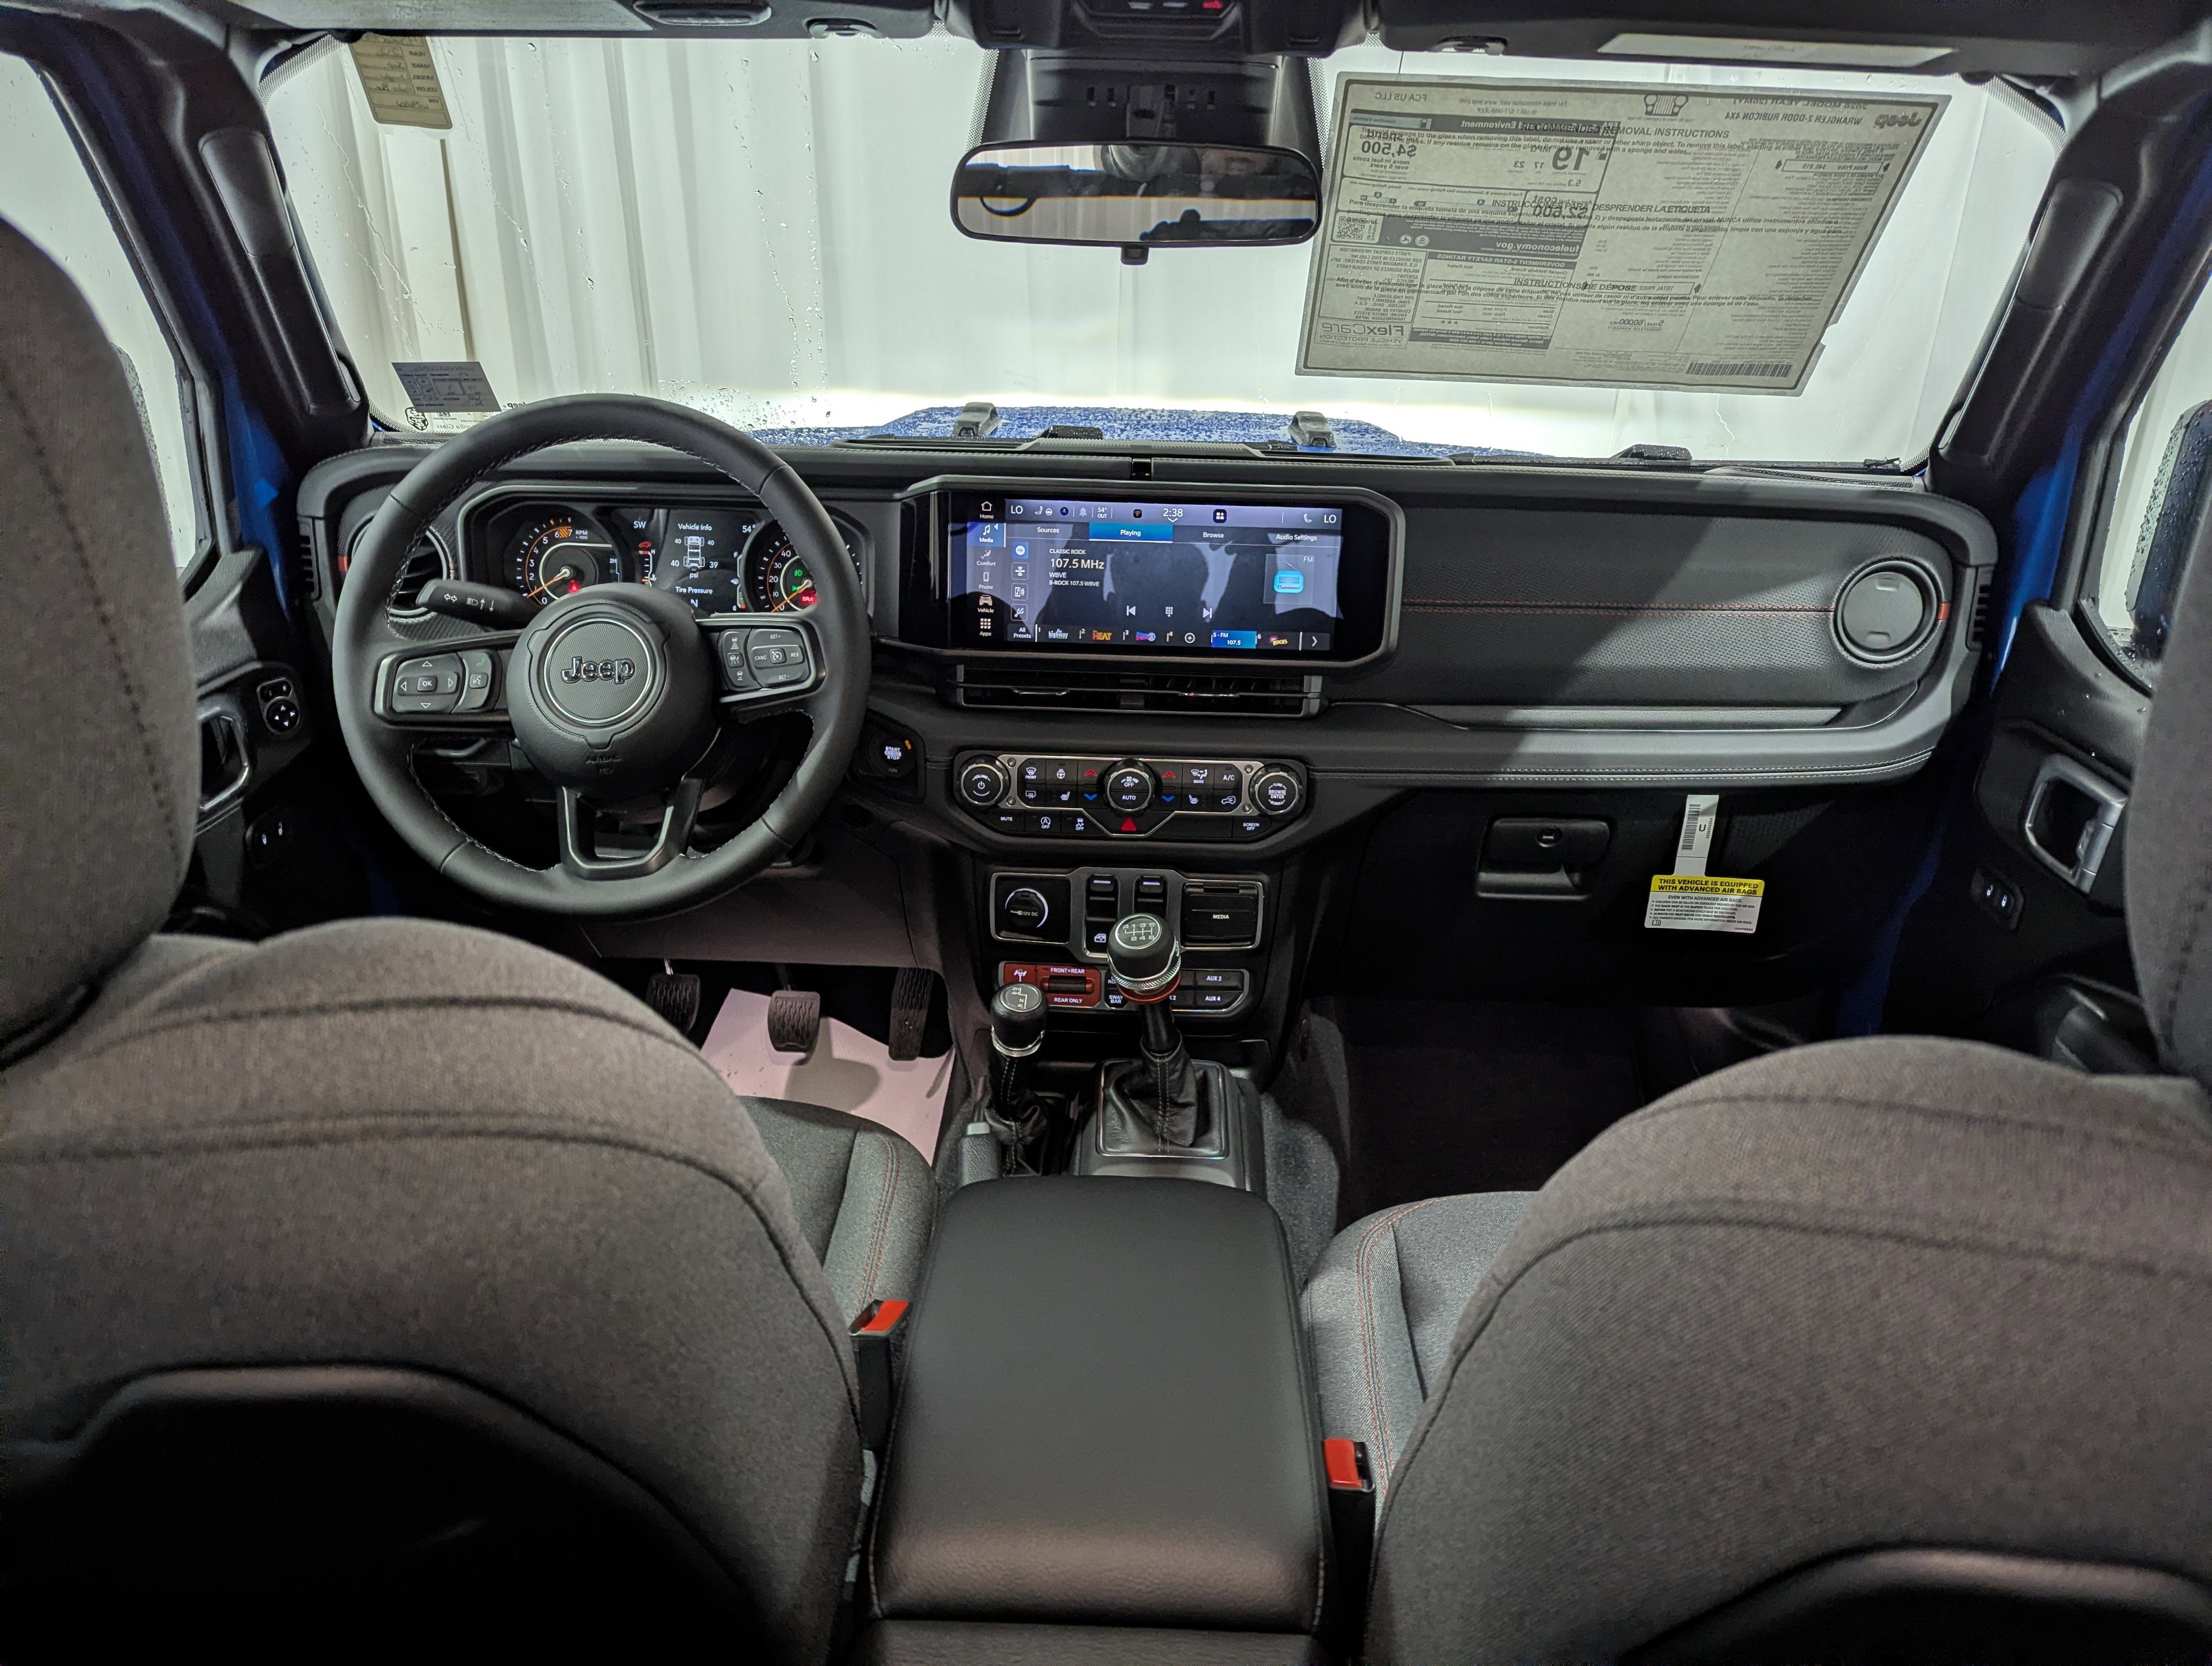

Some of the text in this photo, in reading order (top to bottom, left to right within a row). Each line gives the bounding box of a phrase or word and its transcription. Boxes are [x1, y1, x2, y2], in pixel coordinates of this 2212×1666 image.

[1604, 125, 1729, 138] REMOVAL INSTRUCTIONS
[1592, 204, 1652, 212] DESPRENDER
[1514, 278, 1581, 289] INSTRUCTIONS
[1011, 505, 1023, 515] LO
[1163, 508, 1184, 517] 2:38
[1324, 514, 1336, 523] LO
[634, 521, 646, 529] SW
[1051, 559, 1105, 569] 107.5 MHz
[691, 599, 698, 607] N
[1049, 631, 1068, 639] highway
[1092, 631, 1112, 640] HEAT
[561, 656, 635, 684] Jeep
[1699, 824, 1706, 832] U
